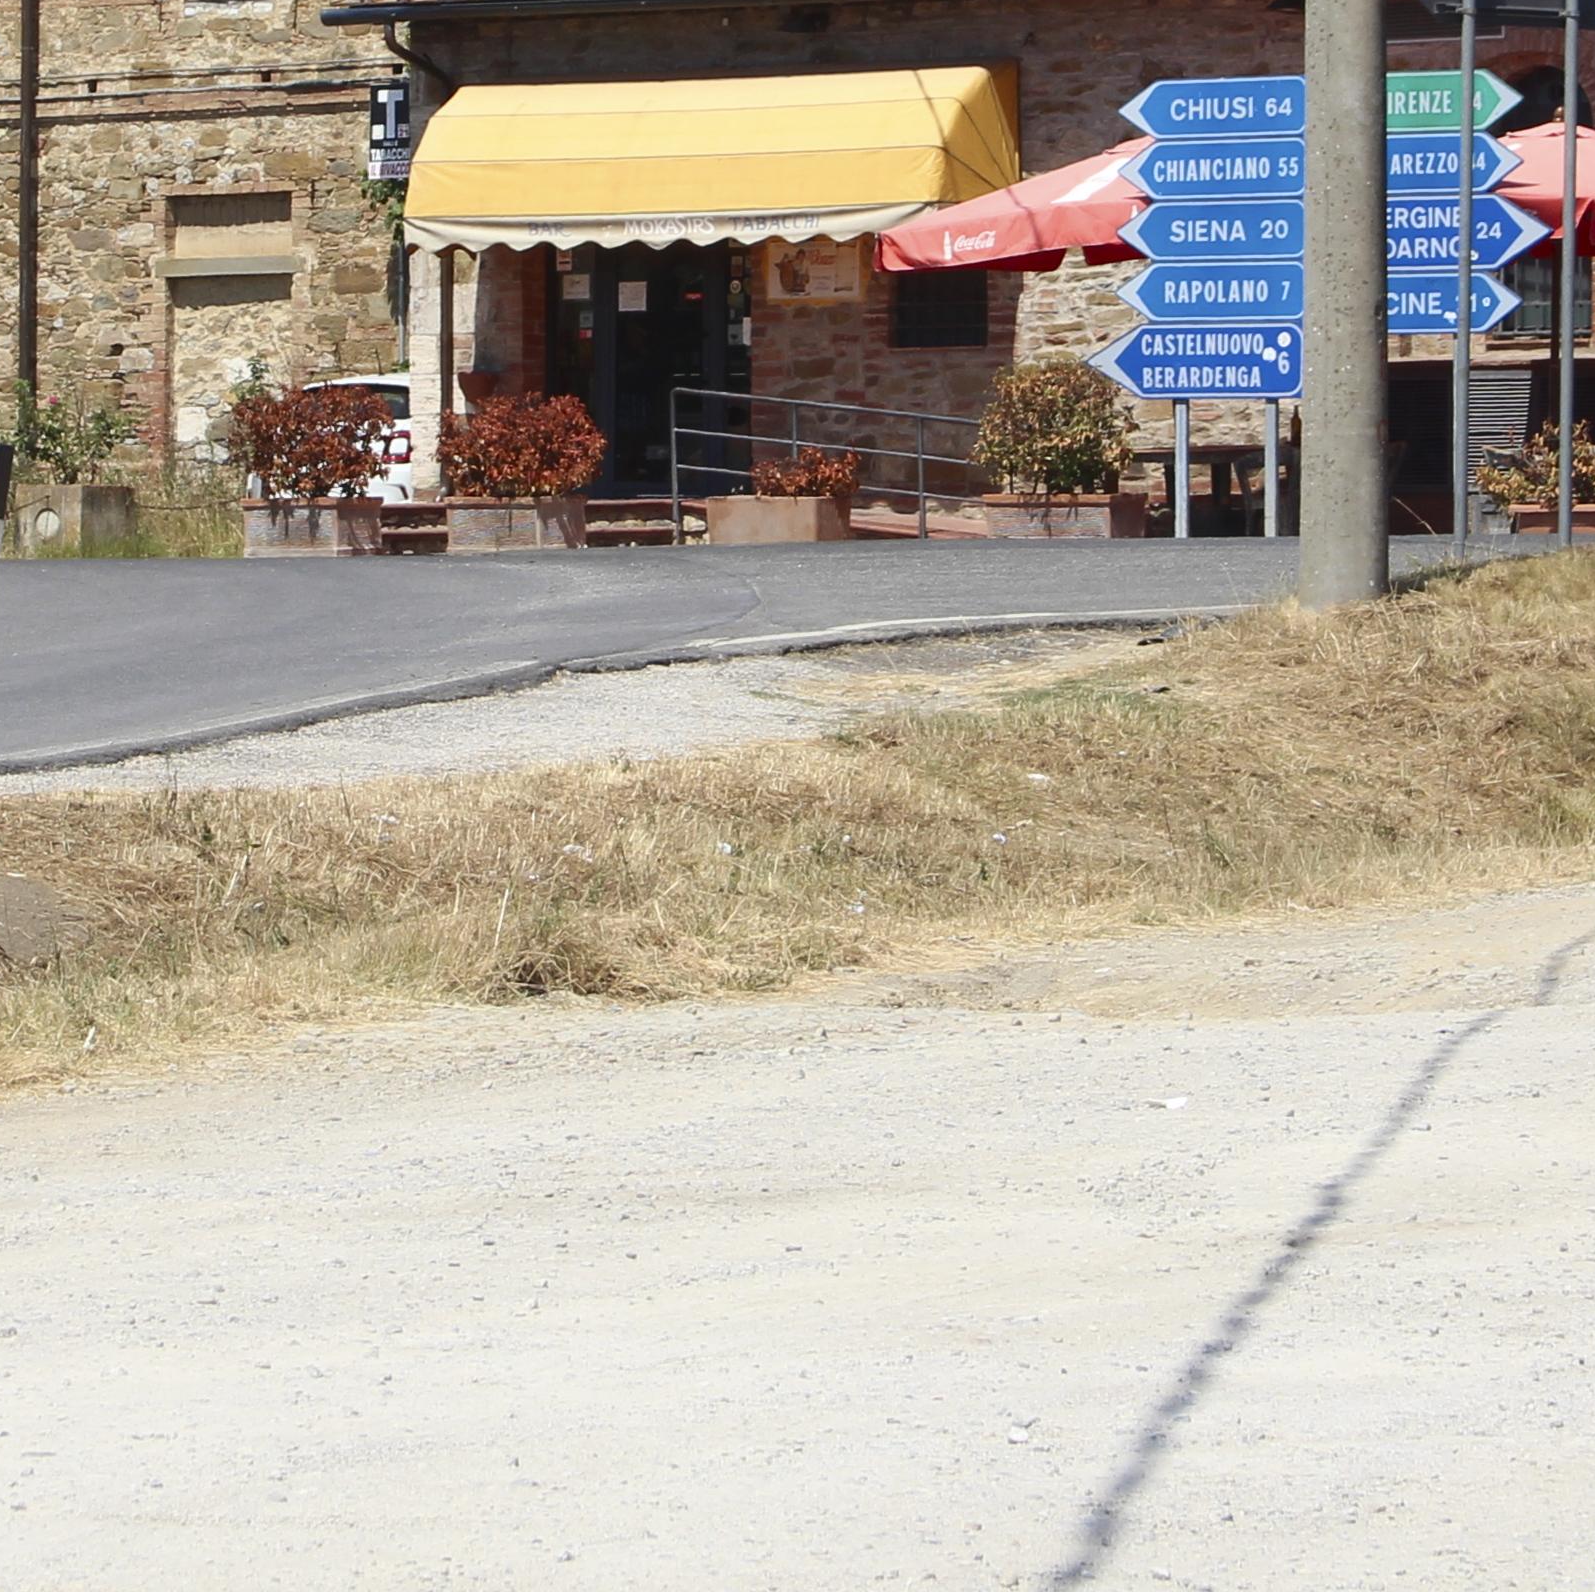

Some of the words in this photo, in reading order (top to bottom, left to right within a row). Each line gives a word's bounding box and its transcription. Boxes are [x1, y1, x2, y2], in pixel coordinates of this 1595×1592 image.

[1170, 96, 1254, 121] CHIUSI
[1265, 97, 1293, 117] 64
[1387, 90, 1453, 115] IRENZE
[1153, 156, 1270, 183] CHIANCIANO
[1277, 157, 1299, 177] 55
[1389, 151, 1459, 175] AREZZO
[528, 221, 572, 237] BAR
[623, 215, 716, 236] MOKASIRS
[728, 216, 821, 231] TABACCHI
[1169, 219, 1246, 243] SIENA
[1260, 219, 1289, 239] 20
[1387, 206, 1460, 229] ERGINE
[1476, 221, 1502, 240] 24
[1387, 235, 1460, 259] DARNO
[1164, 279, 1269, 304] RAPOLANO
[1281, 281, 1291, 301] 7
[1387, 291, 1443, 315] CINE
[1141, 333, 1264, 356] CASTELNUOVO
[1277, 351, 1291, 374] 6
[1142, 366, 1262, 389] BERARDENGA
